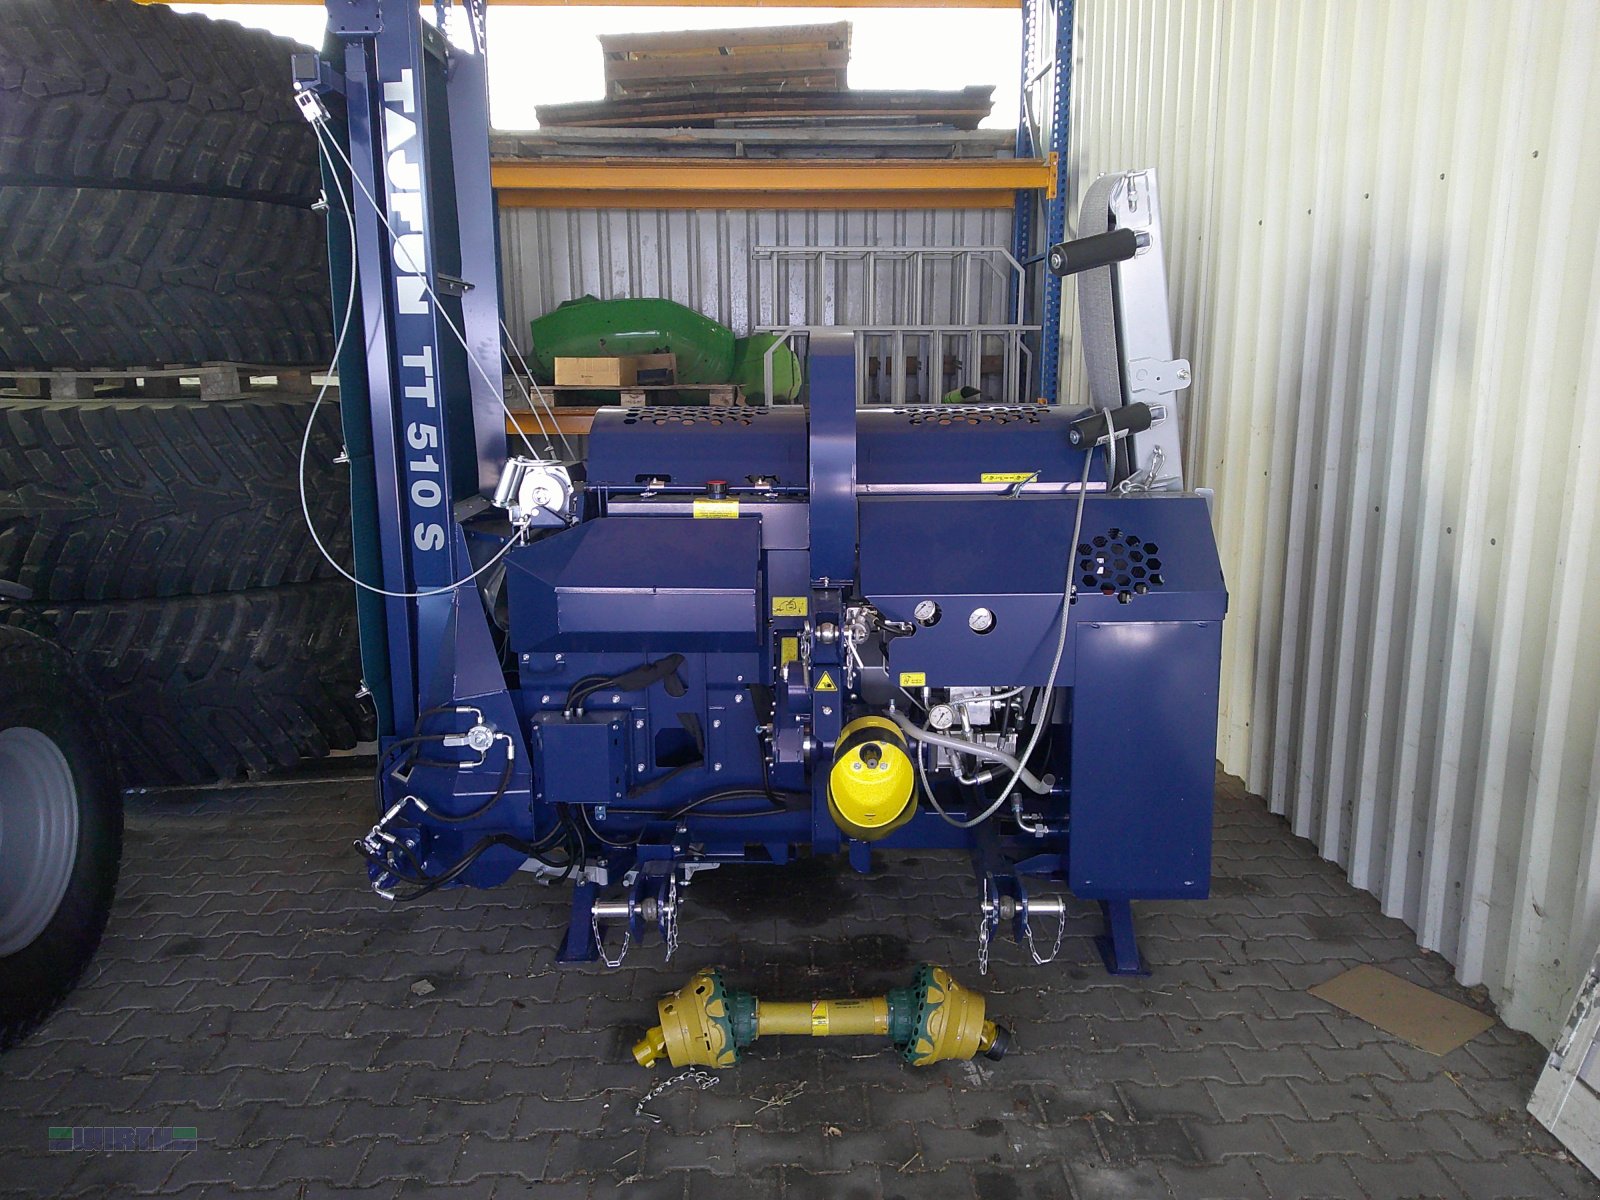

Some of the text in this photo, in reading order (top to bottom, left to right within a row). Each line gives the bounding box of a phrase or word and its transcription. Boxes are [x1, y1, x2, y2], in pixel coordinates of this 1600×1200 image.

[384, 69, 445, 551] TAJFUN TT 510 S
